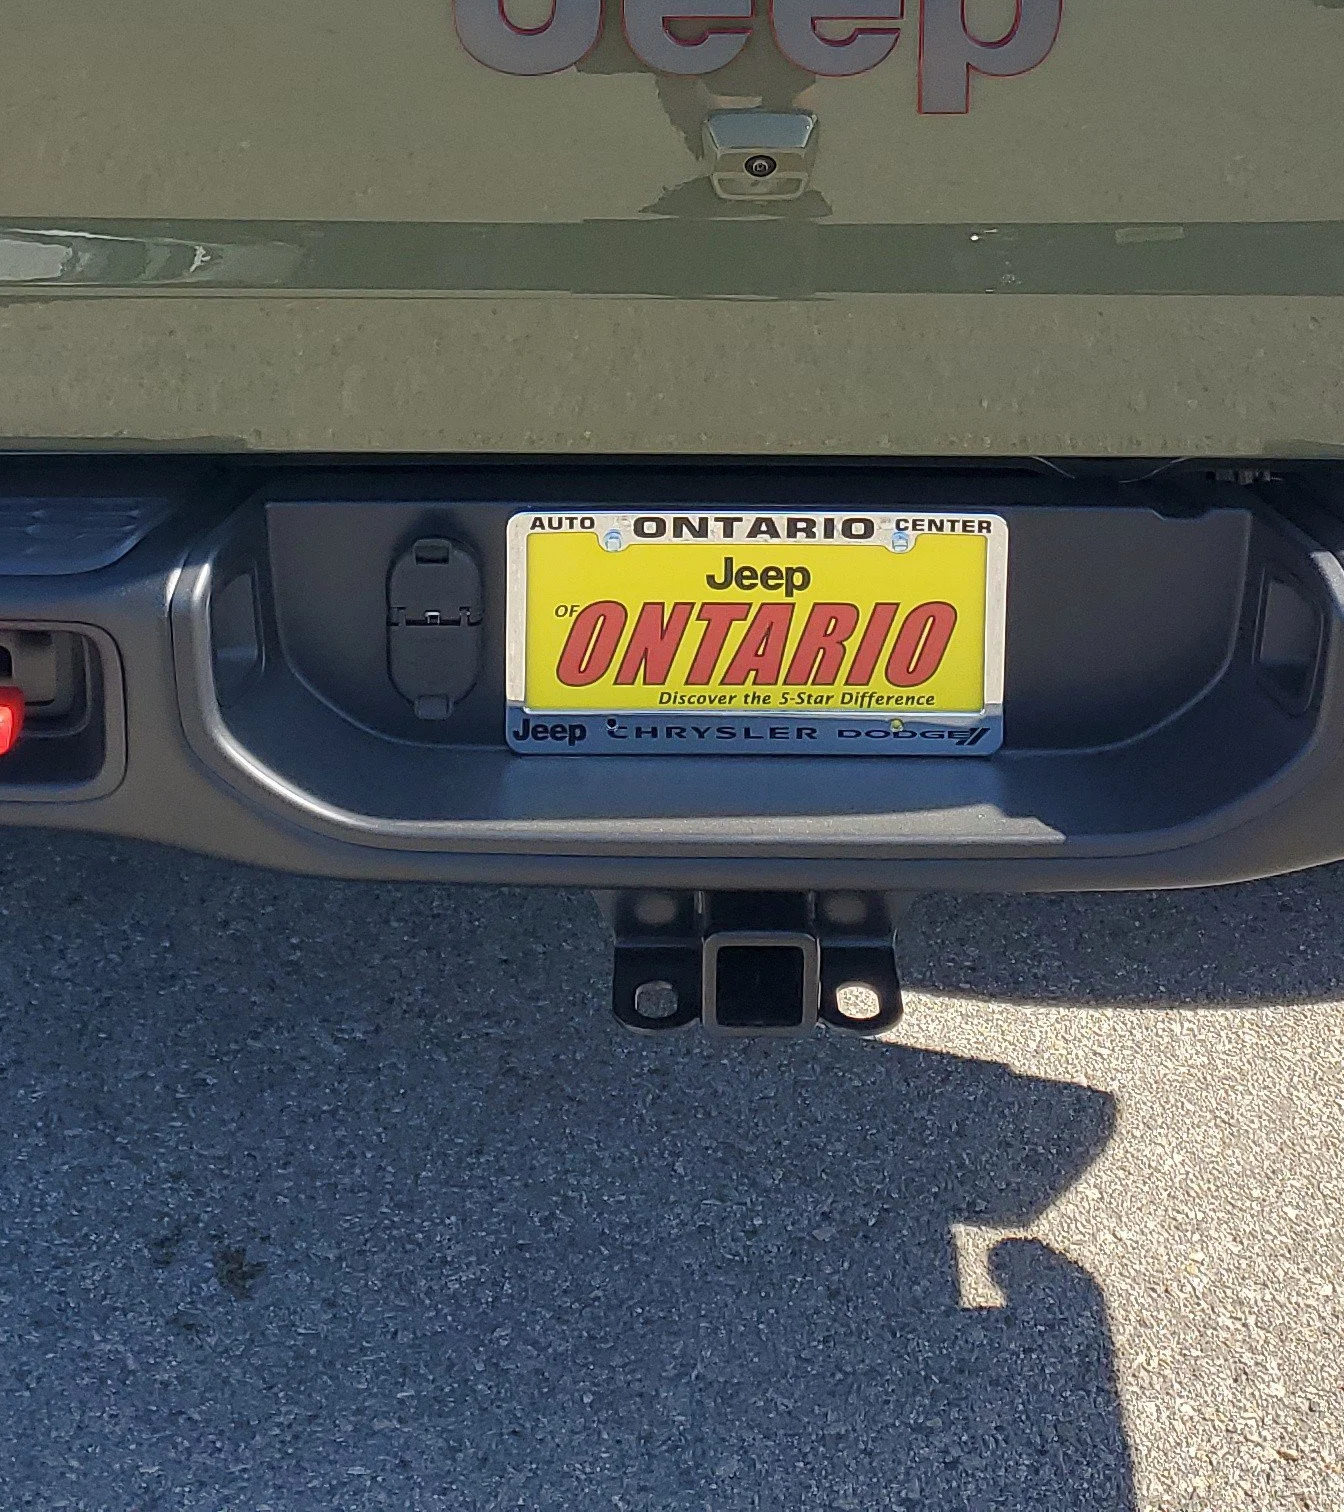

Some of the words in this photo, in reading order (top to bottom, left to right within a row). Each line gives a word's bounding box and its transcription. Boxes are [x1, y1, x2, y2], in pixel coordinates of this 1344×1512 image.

[529, 516, 596, 531] AUTO
[632, 516, 876, 540] ONTARIO
[895, 518, 993, 534] CENTER
[705, 556, 812, 598] Jeep
[554, 604, 580, 618] OF
[555, 599, 958, 688] ONTARIO
[658, 691, 738, 706] Discover
[743, 691, 772, 706] the
[778, 691, 835, 706] 5-Star
[840, 691, 936, 709] Difference
[512, 718, 587, 746] Jeep
[607, 725, 818, 740] CHRYSLER
[837, 728, 970, 740] DODGE
